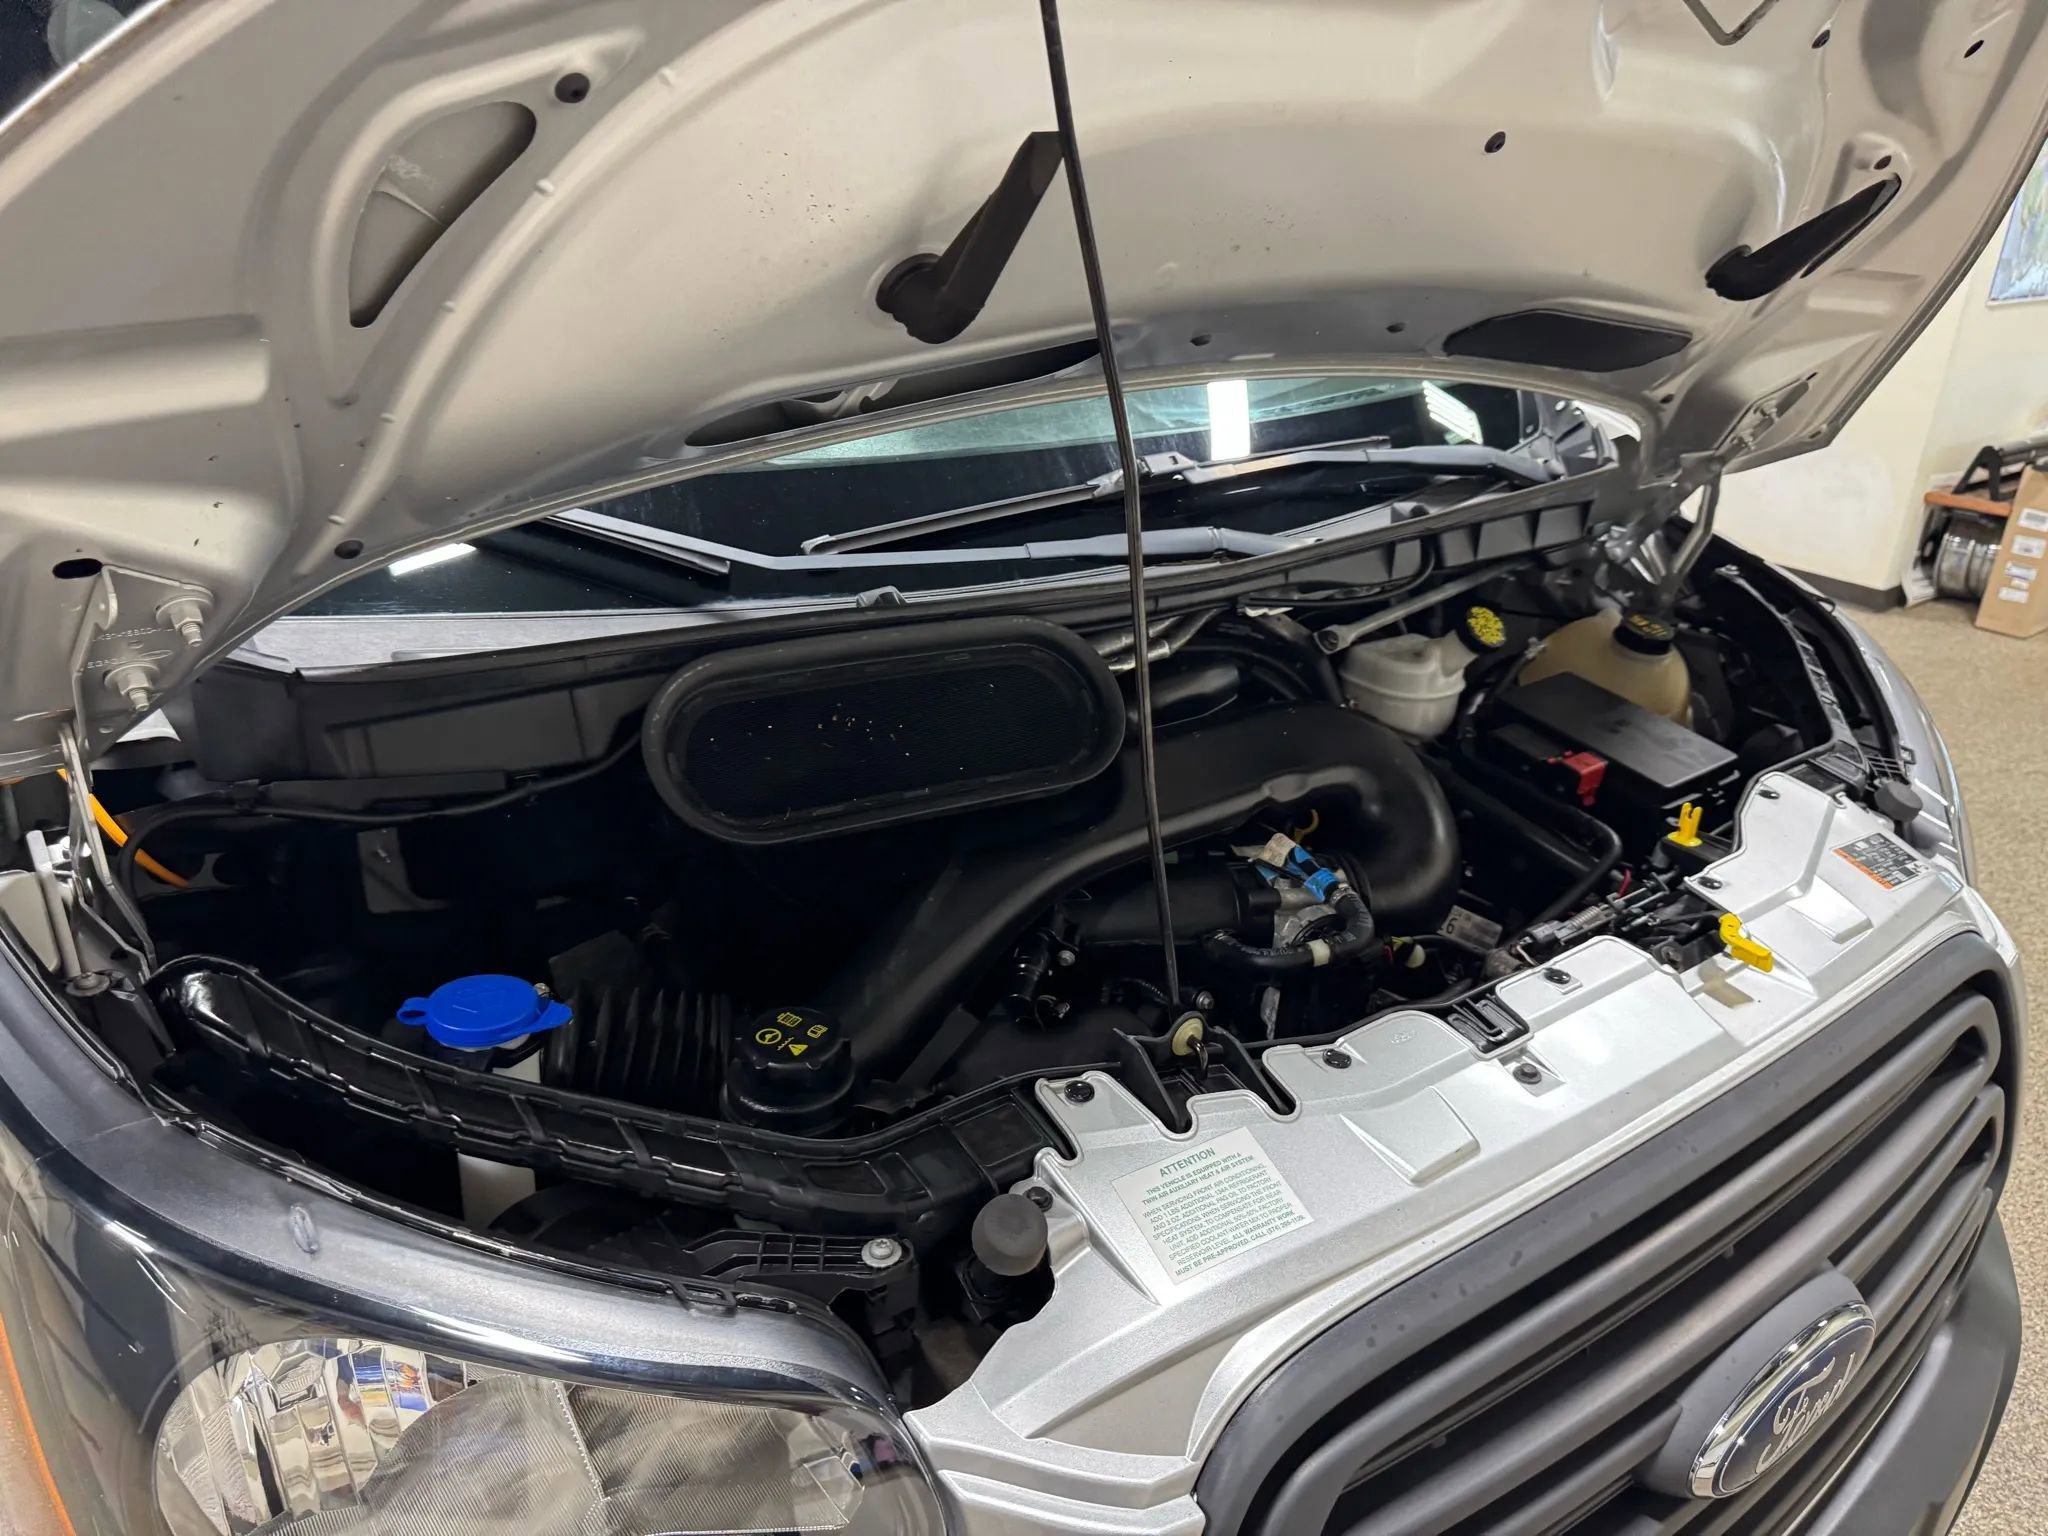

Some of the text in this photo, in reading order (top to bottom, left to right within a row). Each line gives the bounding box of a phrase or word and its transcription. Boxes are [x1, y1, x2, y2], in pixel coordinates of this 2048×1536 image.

[1141, 1195, 1158, 1206] TWIN
[1157, 1190, 1169, 1199] AIR
[1168, 1178, 1199, 1194] AUXILIARY
[1199, 1171, 1215, 1181] HEAT
[1219, 1164, 1232, 1173] AIR
[1230, 1155, 1254, 1168] SYSTEM
[1145, 1185, 1161, 1195] THIS
[1160, 1175, 1186, 1190] VEHICLE
[1192, 1160, 1222, 1176] EQUIPPED
[1221, 1154, 1237, 1164] WITH
[1157, 1147, 1216, 1177] ATTENTION
[1142, 1206, 1162, 1218] WHEN
[1161, 1192, 1194, 1210] SERVICING
[1192, 1184, 1214, 1197] FRONT
[1213, 1179, 1225, 1188] AIR
[1149, 1214, 1164, 1224] ADD
[1167, 1207, 1181, 1216] LBS
[1179, 1192, 1214, 1211] ADDITIONAL
[1214, 1186, 1229, 1196] 134A
[1228, 1169, 1268, 1190] REFRIGERANT
[1151, 1221, 1167, 1232] AND
[1180, 1200, 1216, 1219] ADDITIONAL
[1215, 1194, 1229, 1204] PAG
[1227, 1190, 1240, 1199] OIL
[1238, 1186, 1248, 1194] TO
[1246, 1176, 1272, 1191] FACTORY
[1162, 1233, 1180, 1245] HEAT
[1205, 1218, 1215, 1226] TO
[1213, 1201, 1254, 1222] COMPENSATE
[1252, 1195, 1266, 1205] FOR
[1264, 1188, 1282, 1200] REAR
[1184, 1233, 1200, 1244] ADD
[1198, 1218, 1234, 1238] ADDITIONAL
[1257, 1196, 1284, 1211] FACTORY
[1201, 1207, 1221, 1219] WHEN
[1219, 1193, 1252, 1211] SERVICING
[1250, 1188, 1264, 1198] THE
[1261, 1180, 1282, 1192] FRONT
[1168, 1242, 1202, 1261] SPECIFIED
[1248, 1215, 1261, 1225] MIX
[1259, 1212, 1270, 1220] TO
[1267, 1201, 1293, 1216] PROPER
[1174, 1263, 1194, 1277] MUST
[1192, 1259, 1205, 1268] BE
[1249, 1230, 1268, 1242] CALL
[1176, 1246, 1213, 1266] RESERVOIR
[1231, 1231, 1245, 1241] ALL
[1243, 1216, 1278, 1236] WARRANTY
[1275, 1209, 1295, 1221] WORK
[1755, 1351, 1856, 1474] Ford
